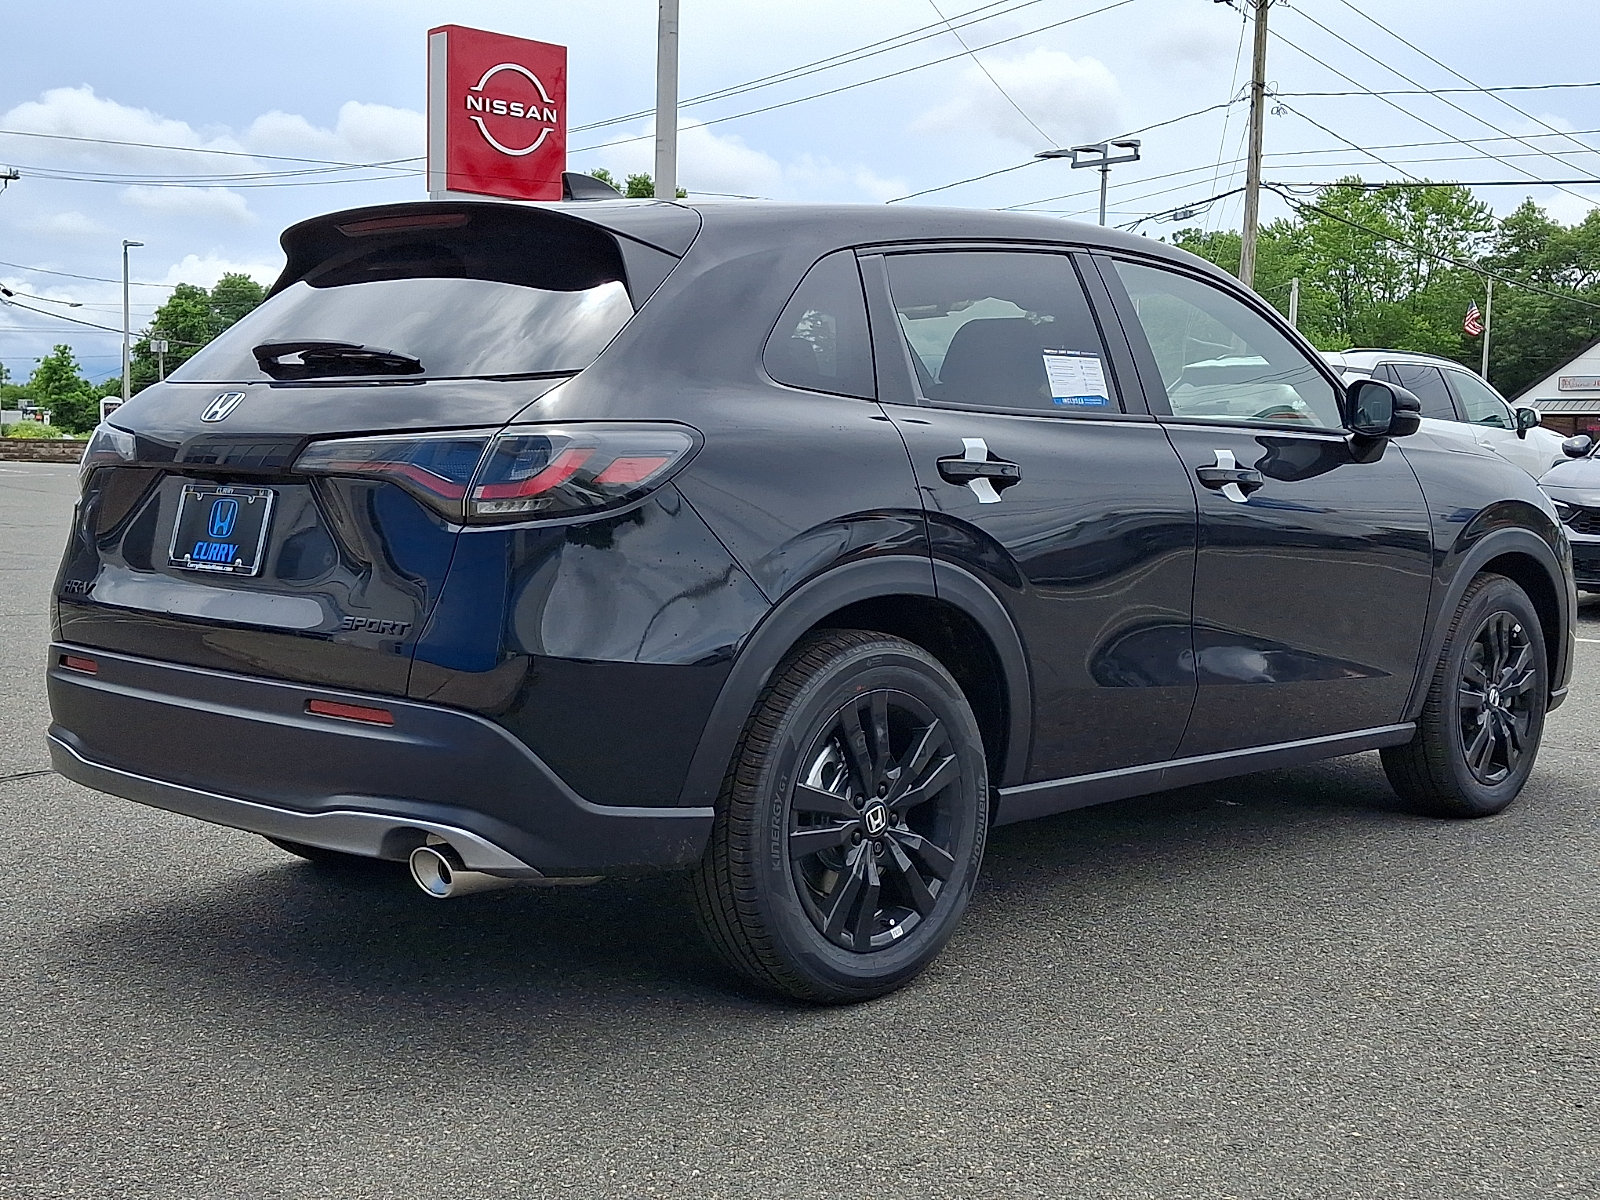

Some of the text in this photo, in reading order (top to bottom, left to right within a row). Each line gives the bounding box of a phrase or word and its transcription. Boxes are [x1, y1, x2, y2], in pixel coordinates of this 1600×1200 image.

[466, 95, 557, 123] NISSAN
[192, 541, 239, 562] CURRY
[65, 580, 95, 594] HR-V
[341, 616, 410, 635] SPORT
[771, 792, 783, 871] KINERGY
